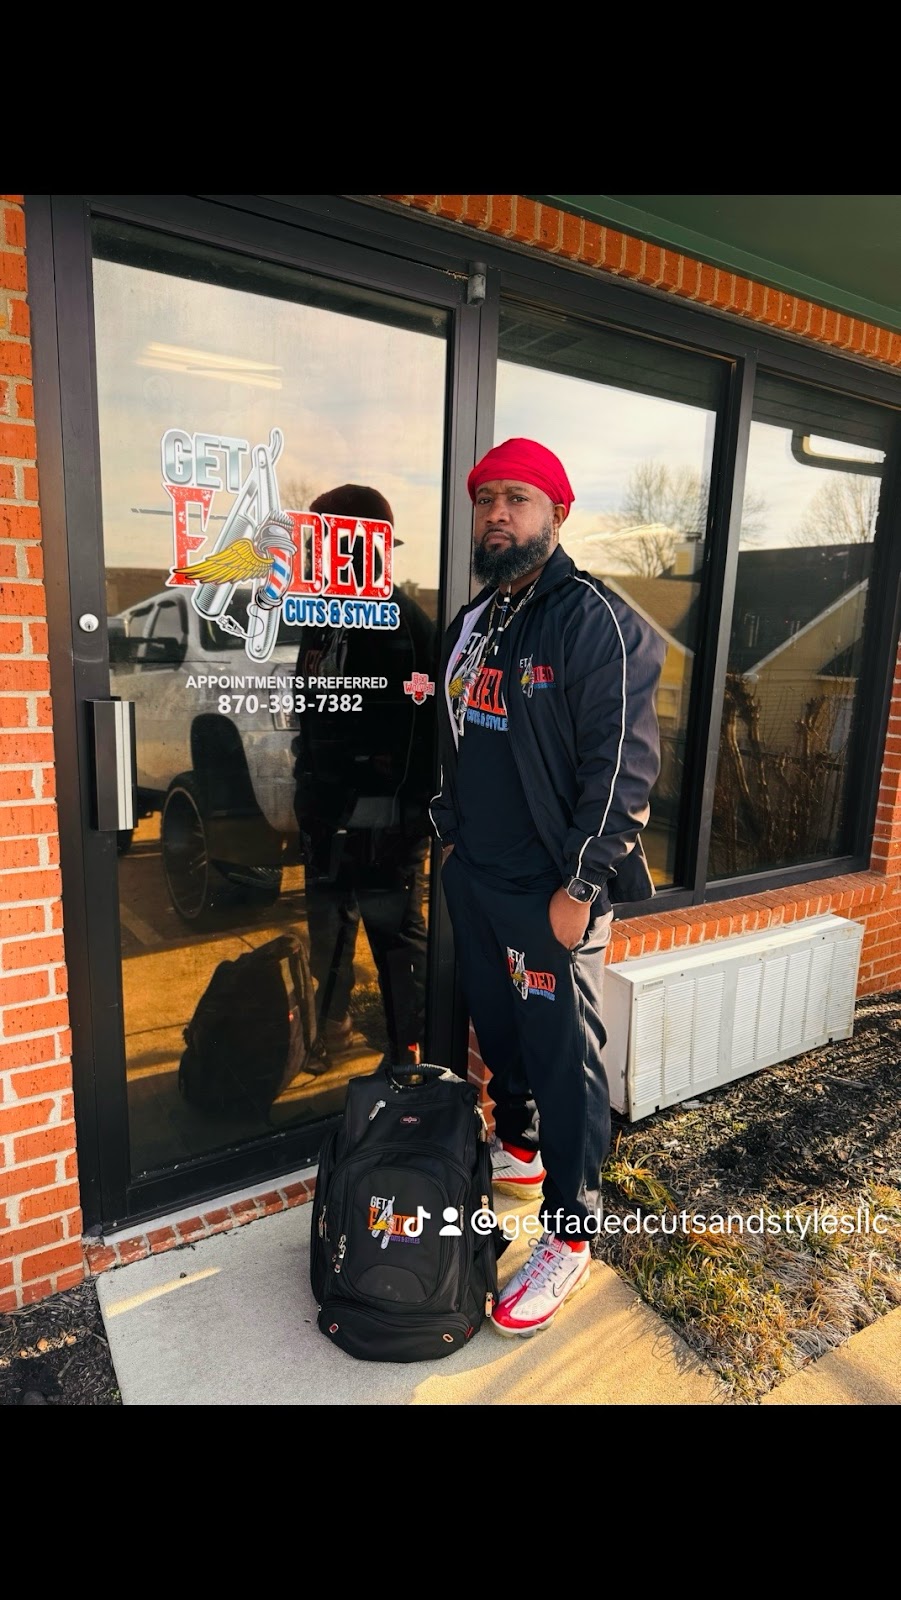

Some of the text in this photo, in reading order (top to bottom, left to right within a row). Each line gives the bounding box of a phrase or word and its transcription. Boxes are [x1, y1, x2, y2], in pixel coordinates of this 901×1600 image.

[161, 429, 248, 493] GET
[165, 442, 394, 645] FADED
[284, 598, 399, 628] CUTS & STYLES
[186, 675, 388, 690] APPOINTMENTS PREFERRED
[217, 694, 363, 714] 870-393-7382
[485, 714, 509, 731] STYLE
[370, 1195, 387, 1210] GET
